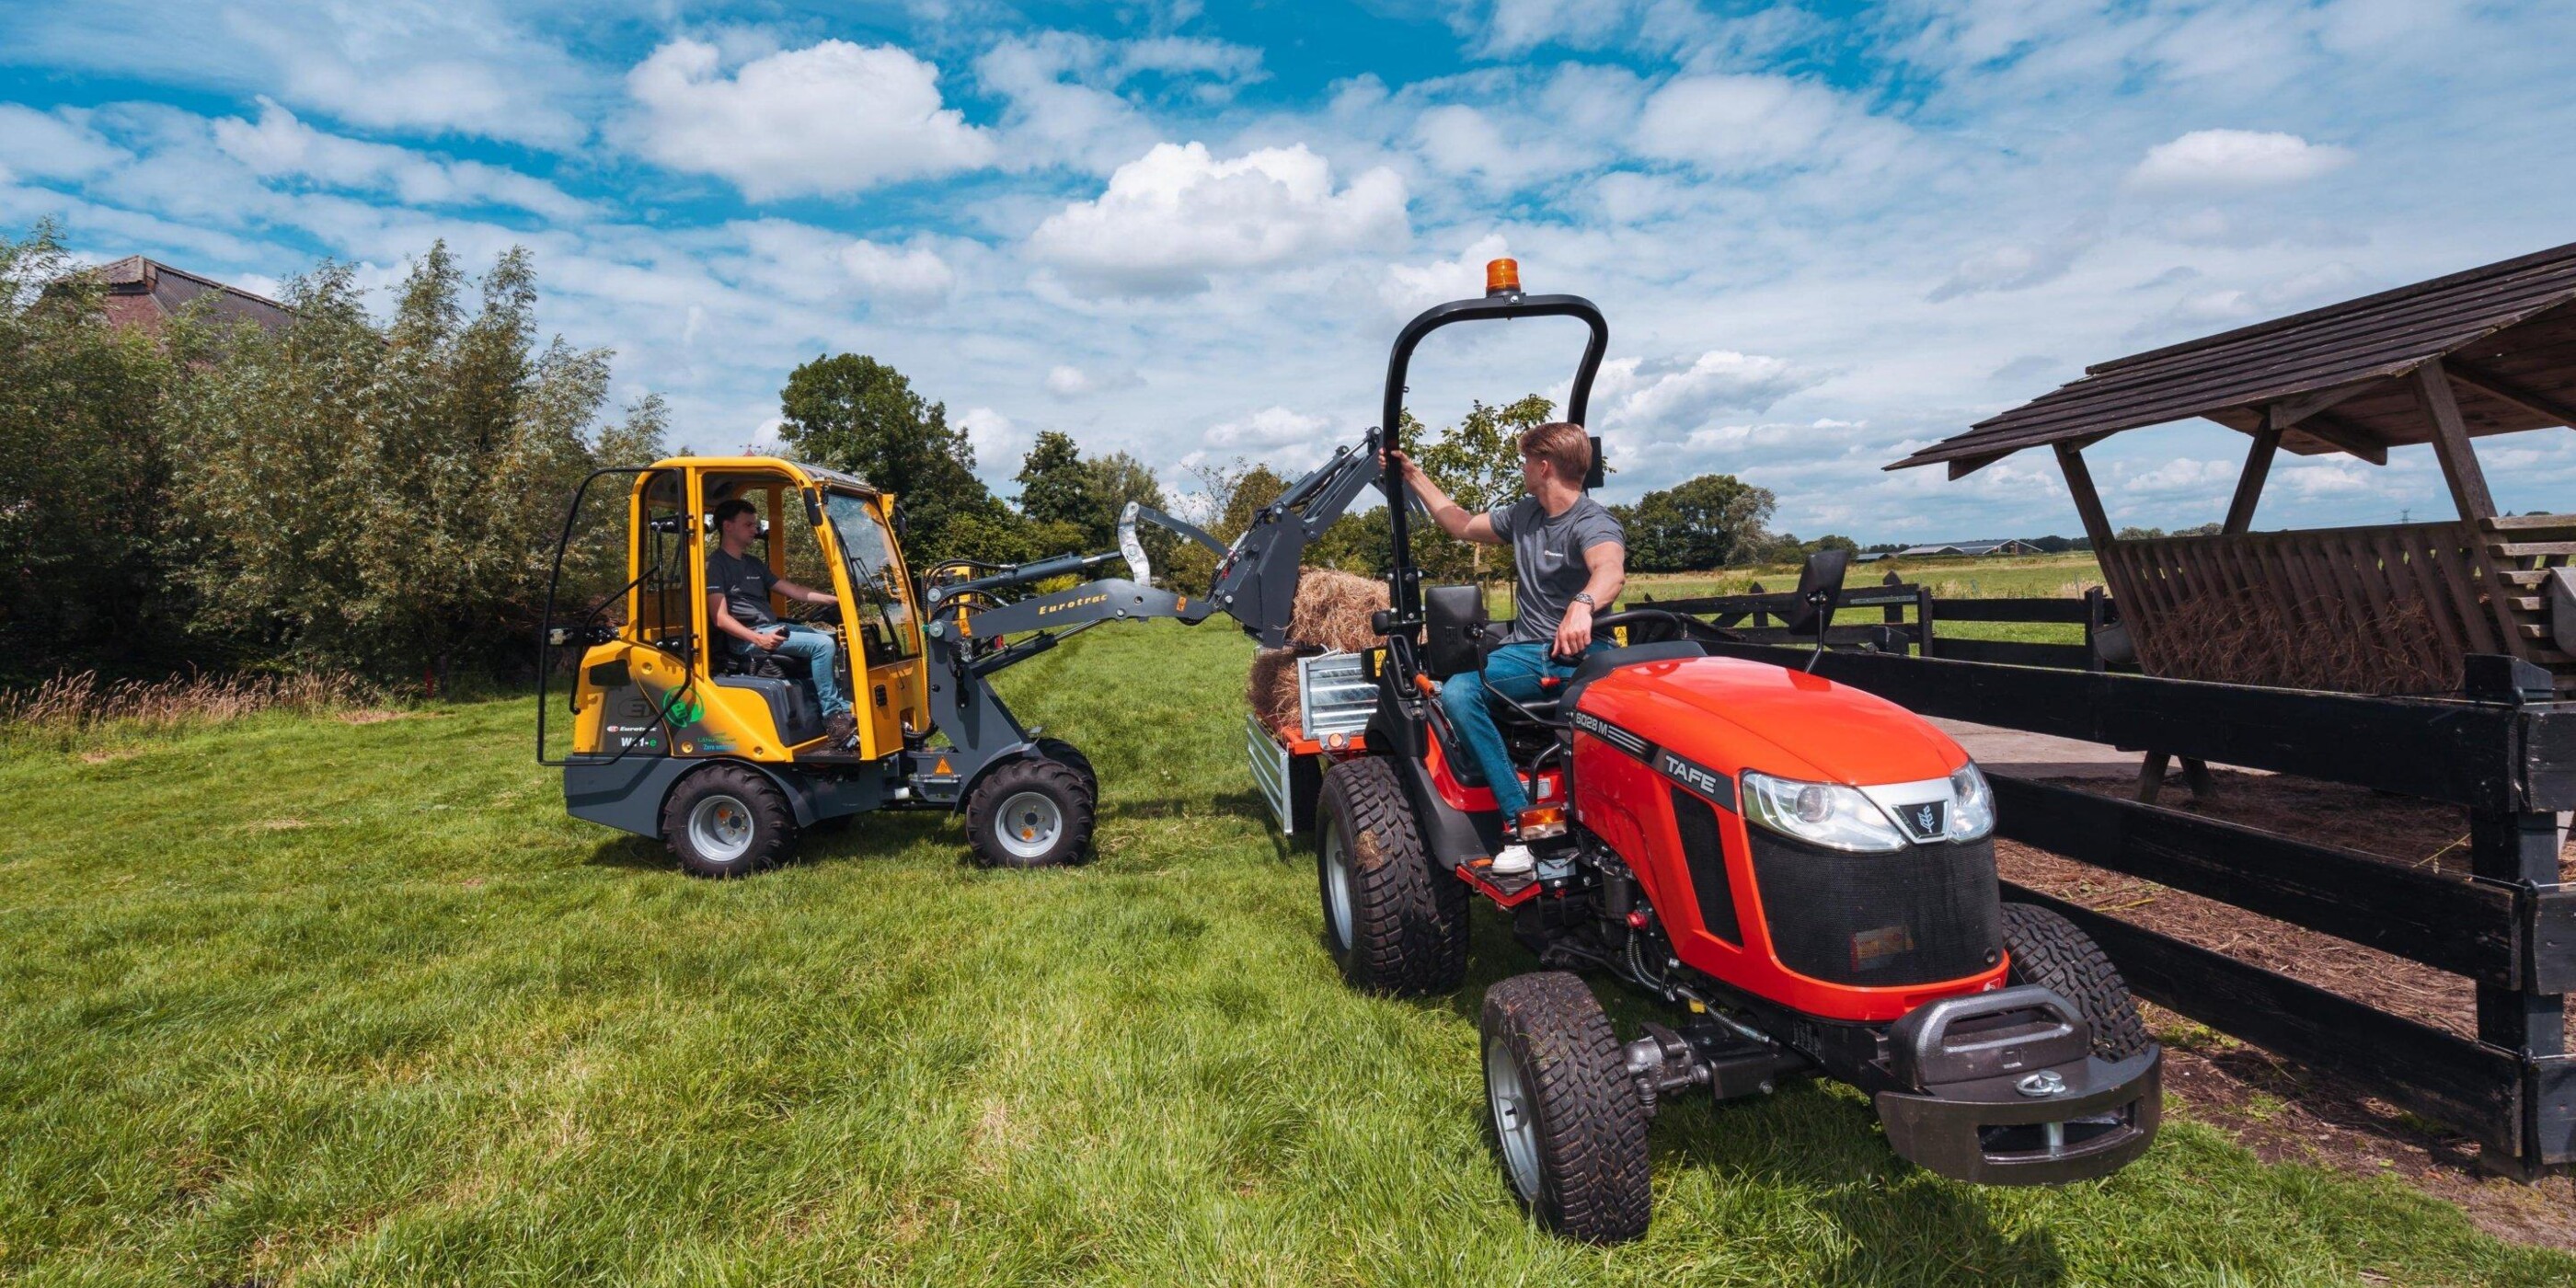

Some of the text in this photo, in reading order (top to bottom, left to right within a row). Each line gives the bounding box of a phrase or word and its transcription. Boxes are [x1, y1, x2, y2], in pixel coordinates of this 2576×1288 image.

[1038, 593, 1108, 615] Eurotrac
[1575, 712, 1608, 737] 6028 M
[1665, 754, 1717, 794] TAFE
